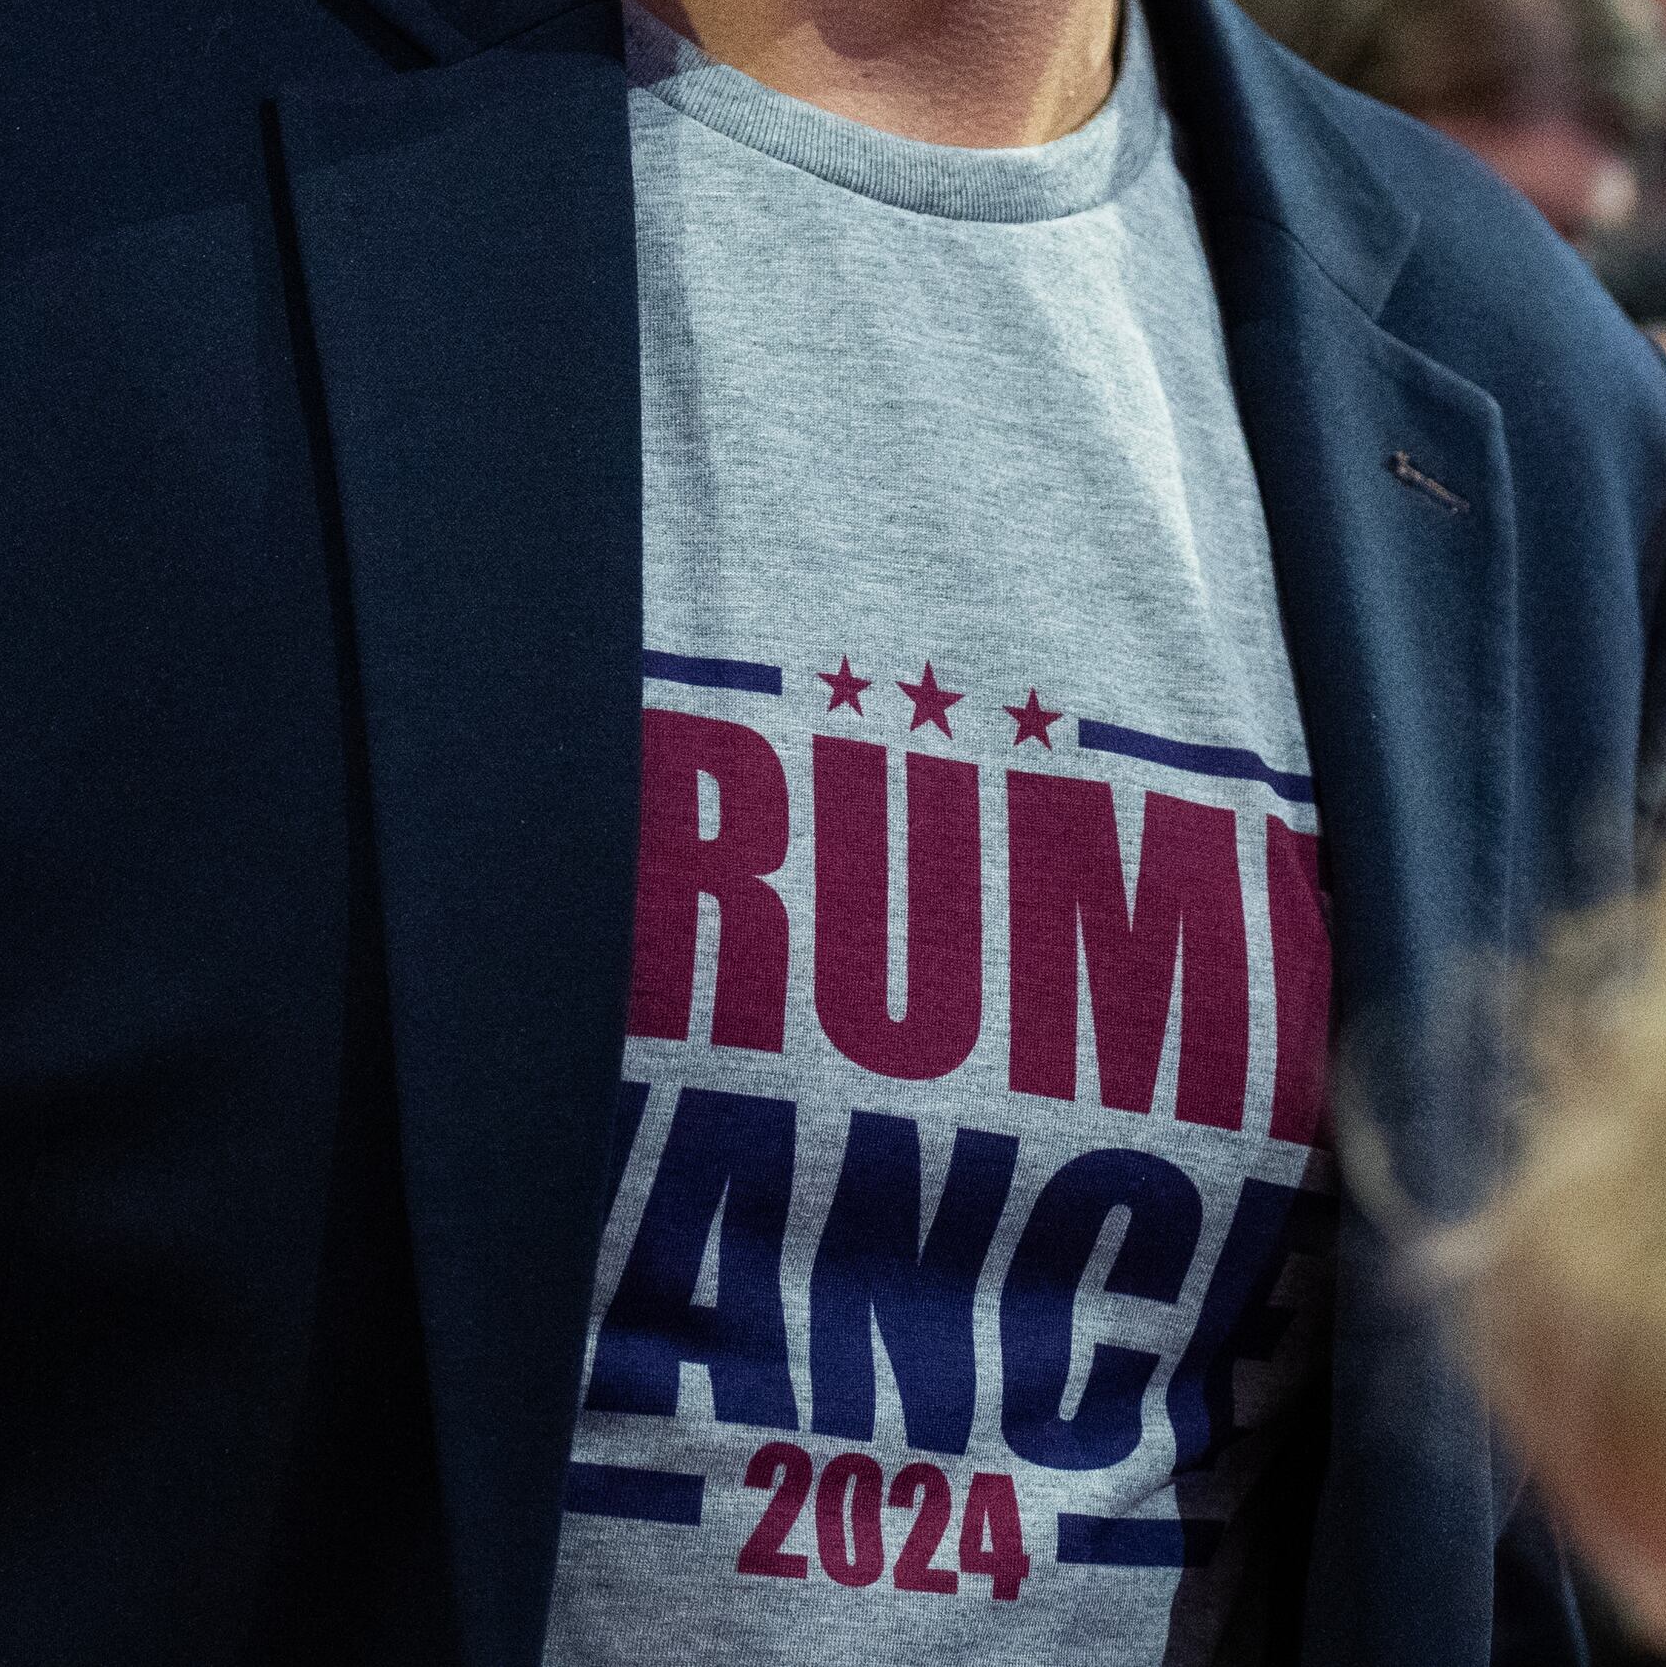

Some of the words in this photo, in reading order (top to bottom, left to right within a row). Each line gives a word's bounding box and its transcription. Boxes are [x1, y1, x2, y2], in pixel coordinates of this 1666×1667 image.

[625, 705, 1333, 1151] RUM
[583, 1081, 1336, 1479] ANCE
[736, 1440, 1031, 1603] 2024
